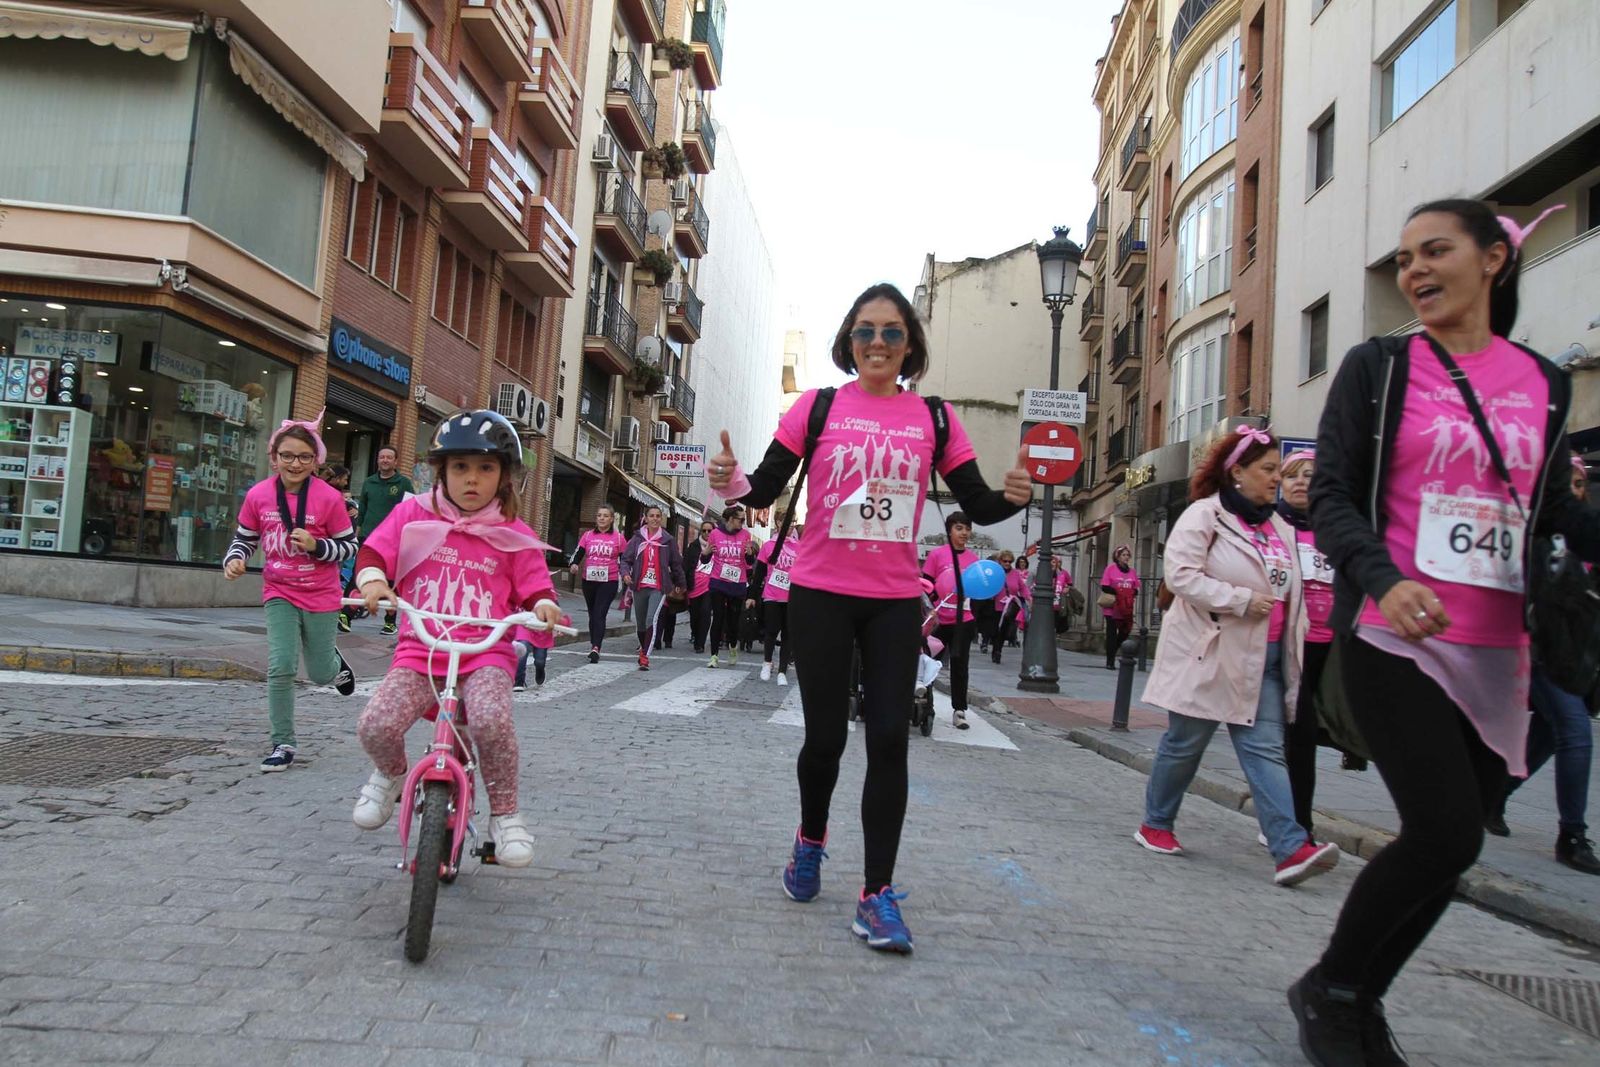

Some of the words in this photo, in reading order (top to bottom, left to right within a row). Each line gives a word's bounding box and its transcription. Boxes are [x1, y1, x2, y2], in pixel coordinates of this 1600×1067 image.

[383, 357, 410, 385] store
[1032, 390, 1054, 399] EXCEPTO
[1055, 392, 1078, 400] GARAJES
[1030, 399, 1043, 407] SOLO
[1044, 400, 1055, 408] CON
[1056, 401, 1070, 409] GRAN
[1072, 402, 1080, 410] VIA
[1028, 408, 1052, 417] CORTADA
[1052, 409, 1059, 417] AL
[1060, 410, 1081, 419] TRAFICO
[844, 417, 880, 428] CARRERA
[829, 422, 840, 430] DE
[841, 423, 851, 431] LA
[852, 423, 881, 434] MUJER
[888, 429, 924, 440] RUNNING
[660, 452, 700, 462] CASERO
[860, 497, 892, 520] 63
[1449, 523, 1513, 561] 649
[1269, 568, 1288, 587] 89
